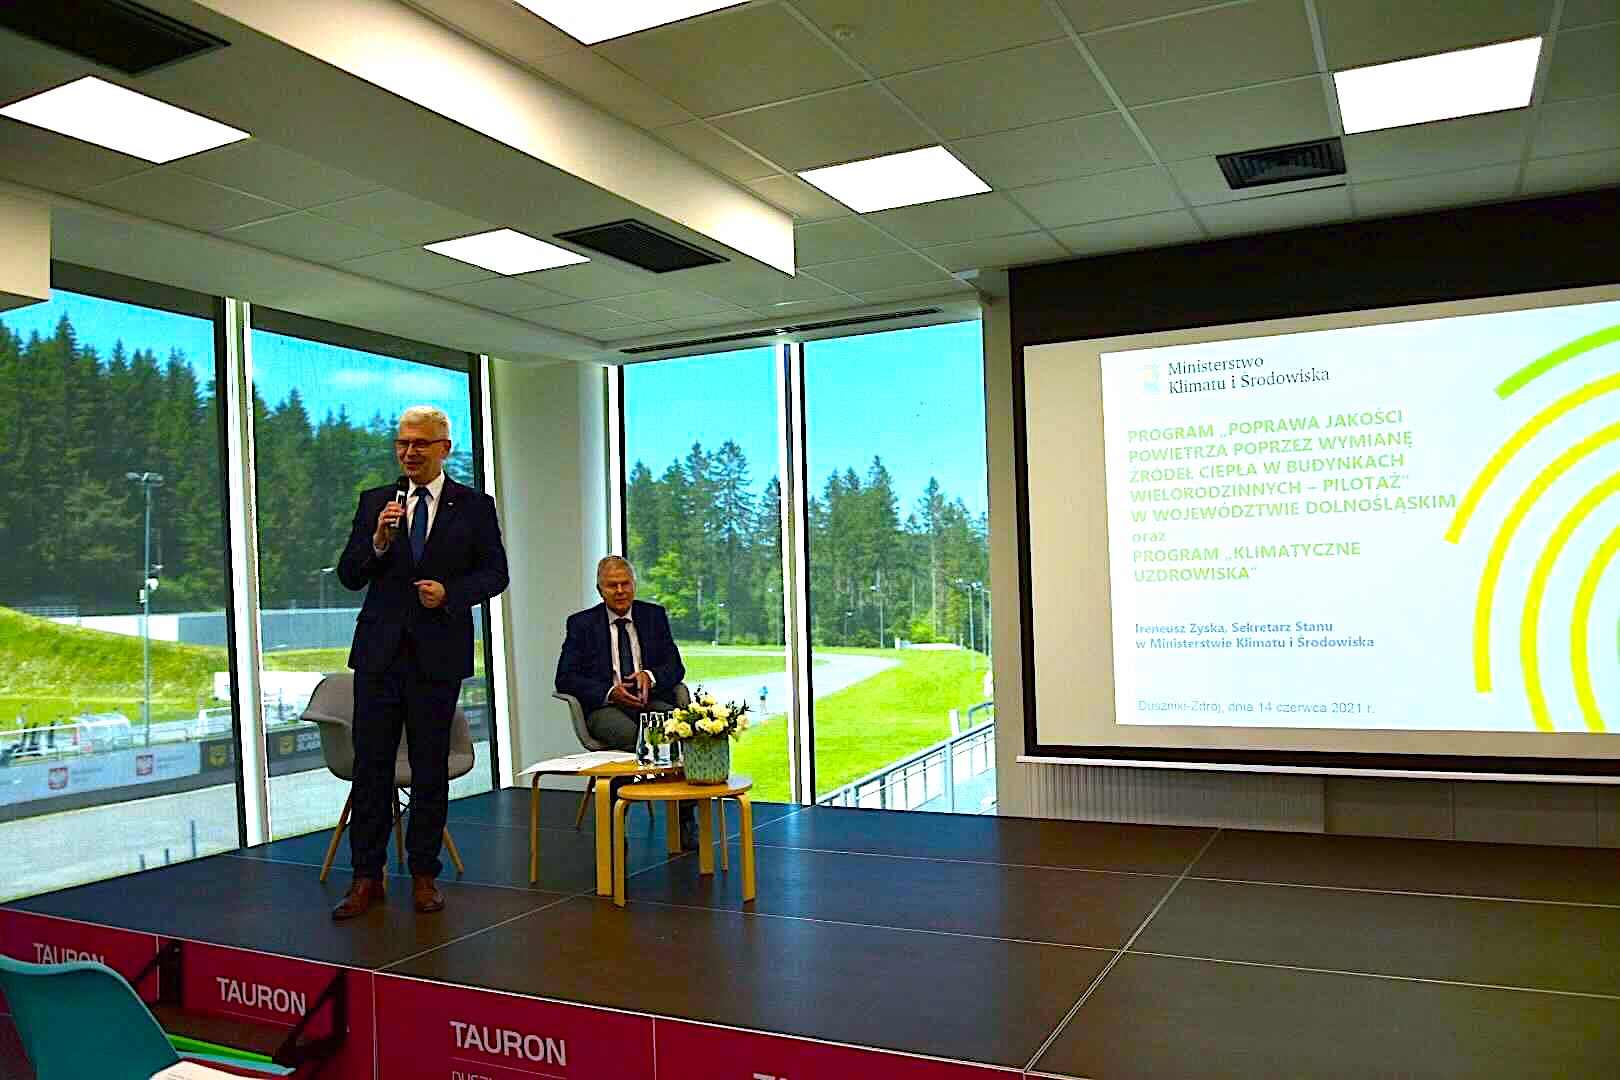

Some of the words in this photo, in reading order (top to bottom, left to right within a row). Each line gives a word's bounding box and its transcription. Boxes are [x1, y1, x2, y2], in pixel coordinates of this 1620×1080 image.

[1168, 356, 1264, 376] Ministerstwo
[1168, 379, 1226, 395] Klimatu
[1231, 375, 1236, 389] i
[1240, 367, 1331, 388] Środowiska
[1128, 424, 1214, 443] PROGRAM
[1325, 406, 1403, 428] JAKOŚCI
[1129, 444, 1228, 463] POWIETRZA
[1233, 438, 1313, 456] POPRZEZ
[1318, 431, 1413, 449] WYMIANĘ
[1129, 465, 1194, 483] ŹRÓDEŁ
[1199, 463, 1257, 479] CIEPŁA
[1263, 461, 1281, 475] W
[1287, 453, 1404, 473] BUDYNKACH
[1130, 481, 1301, 502] WIELORODZINNYCH
[1131, 509, 1147, 523] W
[1152, 502, 1299, 522] WOJEWÓDZTWIE
[1306, 493, 1456, 515] DOLNOŚLĄSKIM
[1132, 531, 1166, 543] oraz
[1133, 547, 1219, 563] PROGRAM
[1135, 623, 1185, 633] Ireneusz
[1189, 622, 1228, 635] Zyska,
[1231, 621, 1291, 633] Sekretarz
[1295, 621, 1333, 632] Stanu
[1135, 640, 1145, 649] w
[1150, 637, 1232, 649] Ministerstwie
[1236, 636, 1285, 648] Klimatu
[1297, 634, 1375, 647] Środowiska
[1228, 701, 1253, 712] dnia
[1259, 701, 1272, 712] 14
[1276, 703, 1327, 713] czerwca
[1331, 702, 1361, 713] 2021
[215, 976, 306, 1016] TAURON
[449, 1020, 567, 1067] TAURON
